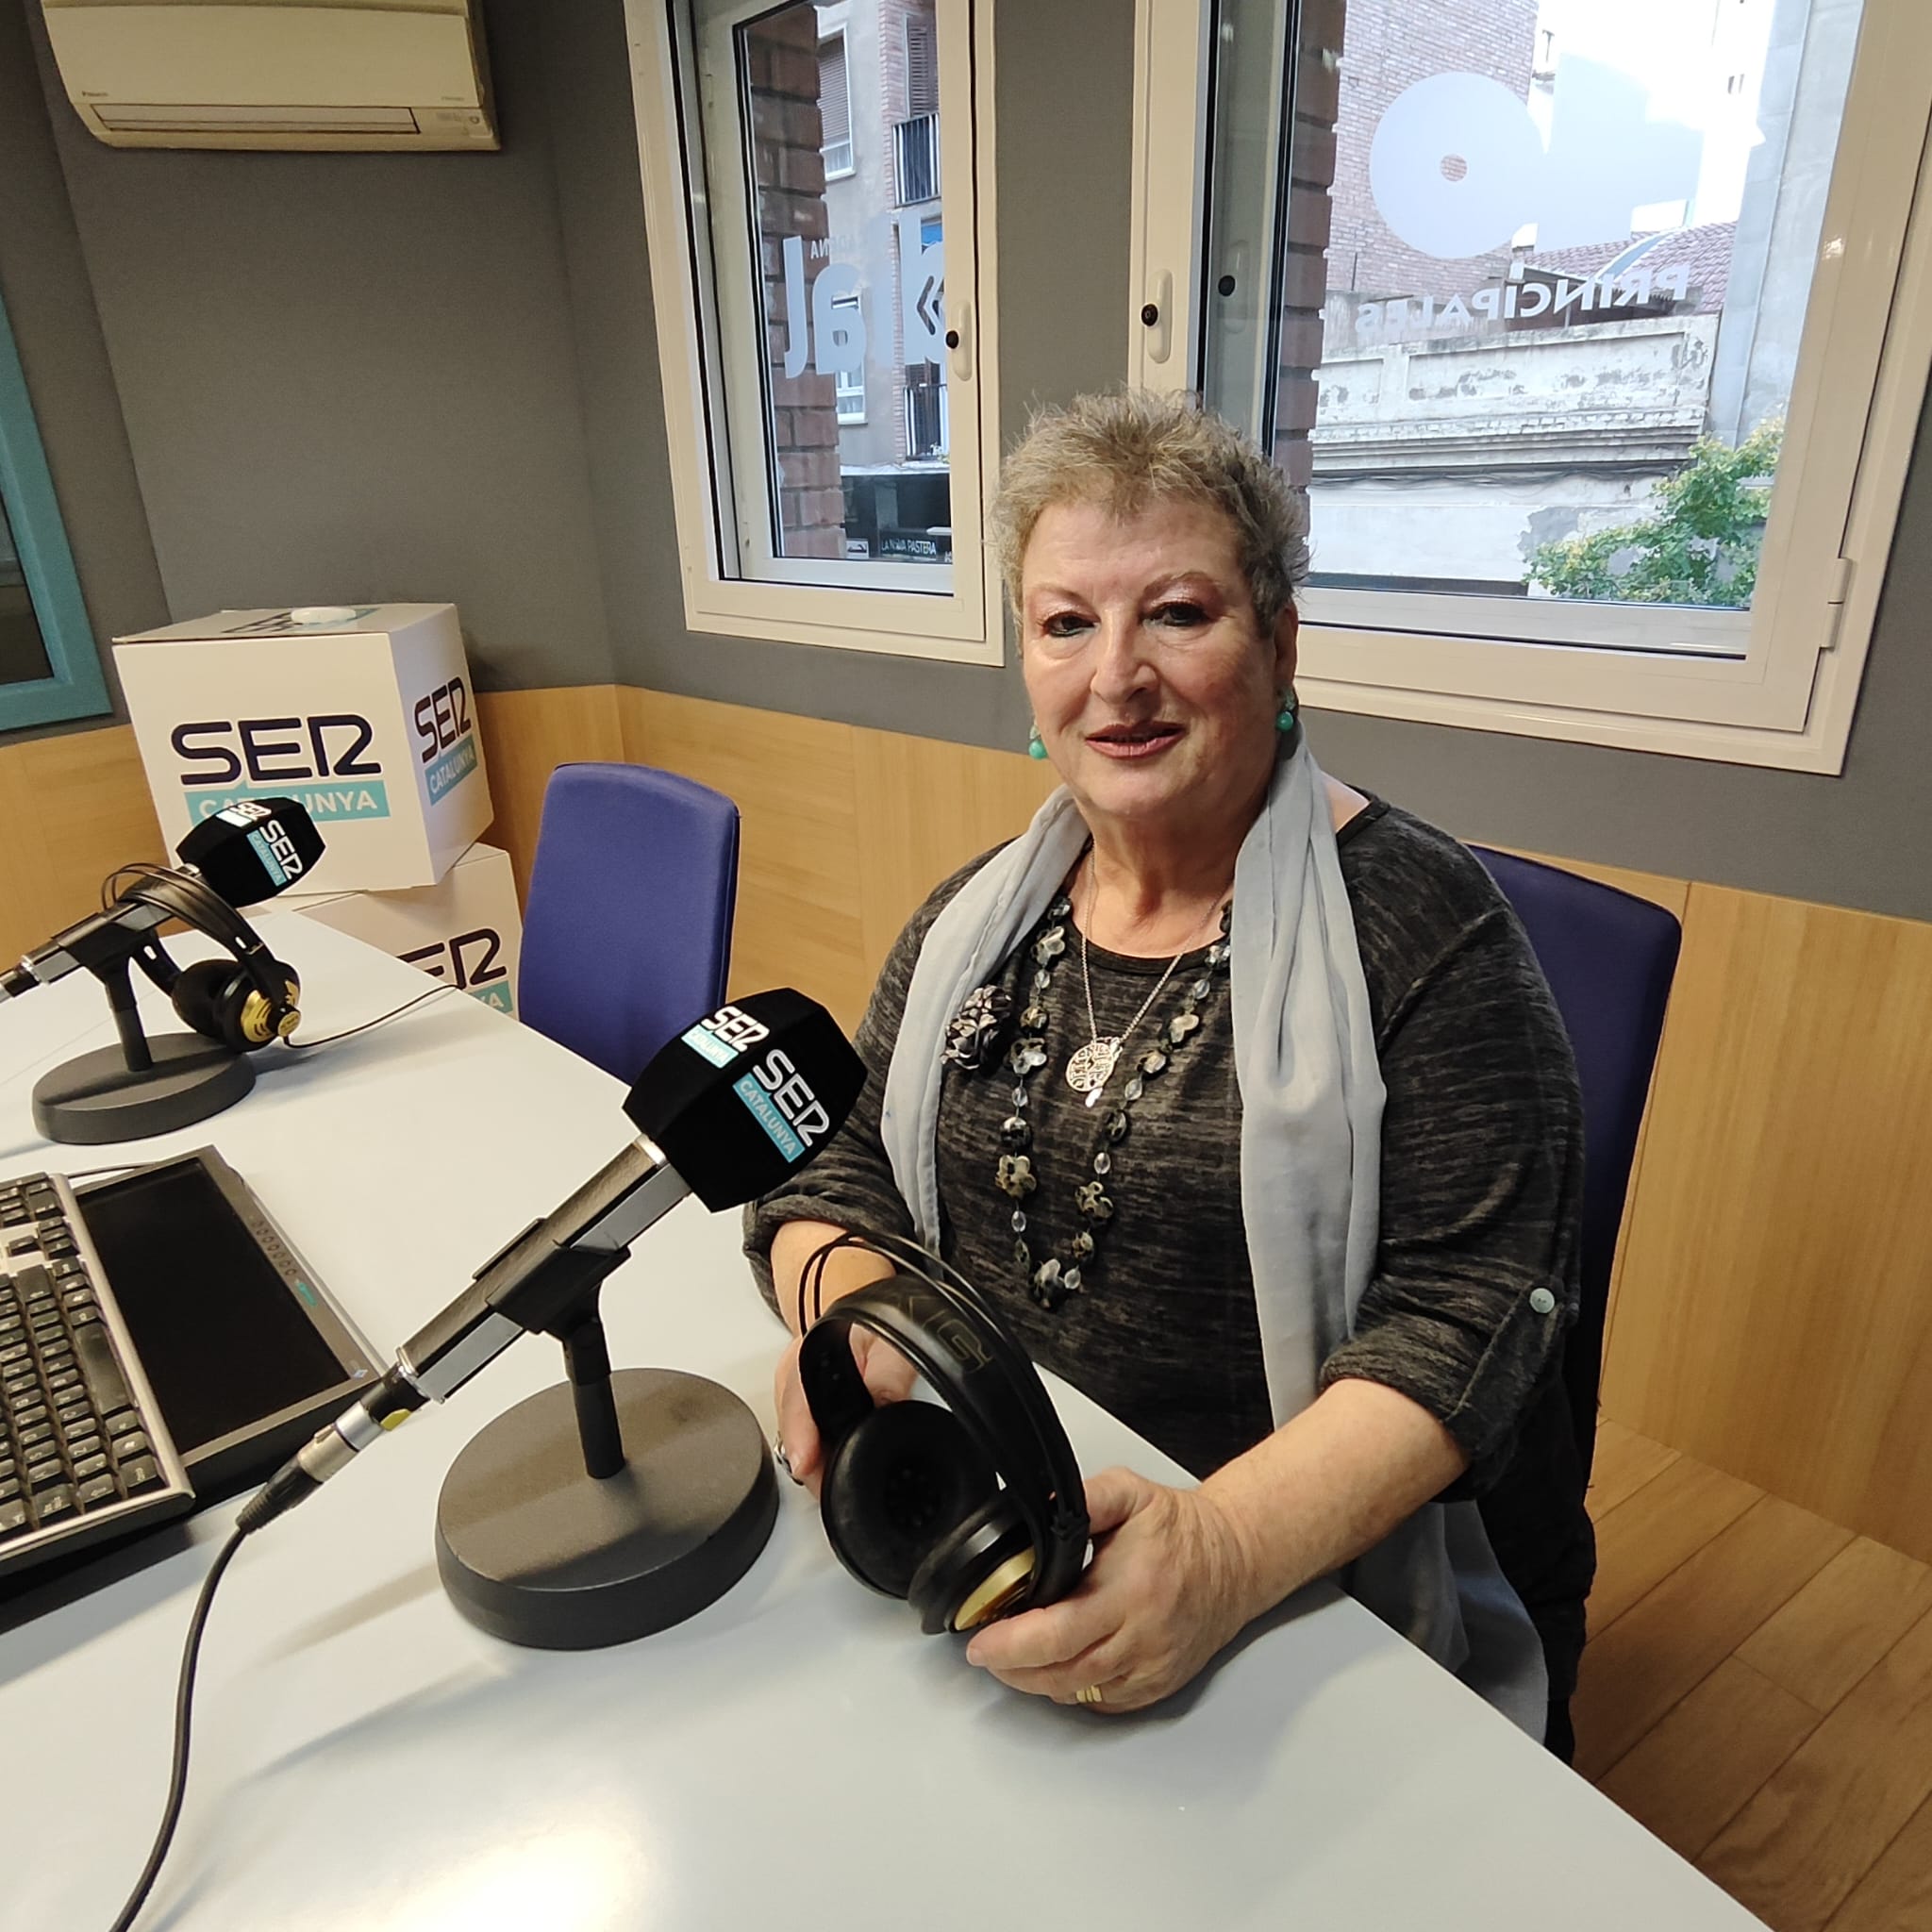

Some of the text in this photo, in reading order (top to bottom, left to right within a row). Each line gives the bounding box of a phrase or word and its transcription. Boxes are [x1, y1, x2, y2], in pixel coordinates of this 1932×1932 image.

[171, 714, 382, 785] SER
[415, 676, 472, 764] SER
[259, 820, 303, 879] SER
[701, 1006, 770, 1053] SER
[740, 1080, 796, 1155] CATALUNYA
[753, 1049, 830, 1147] SER
